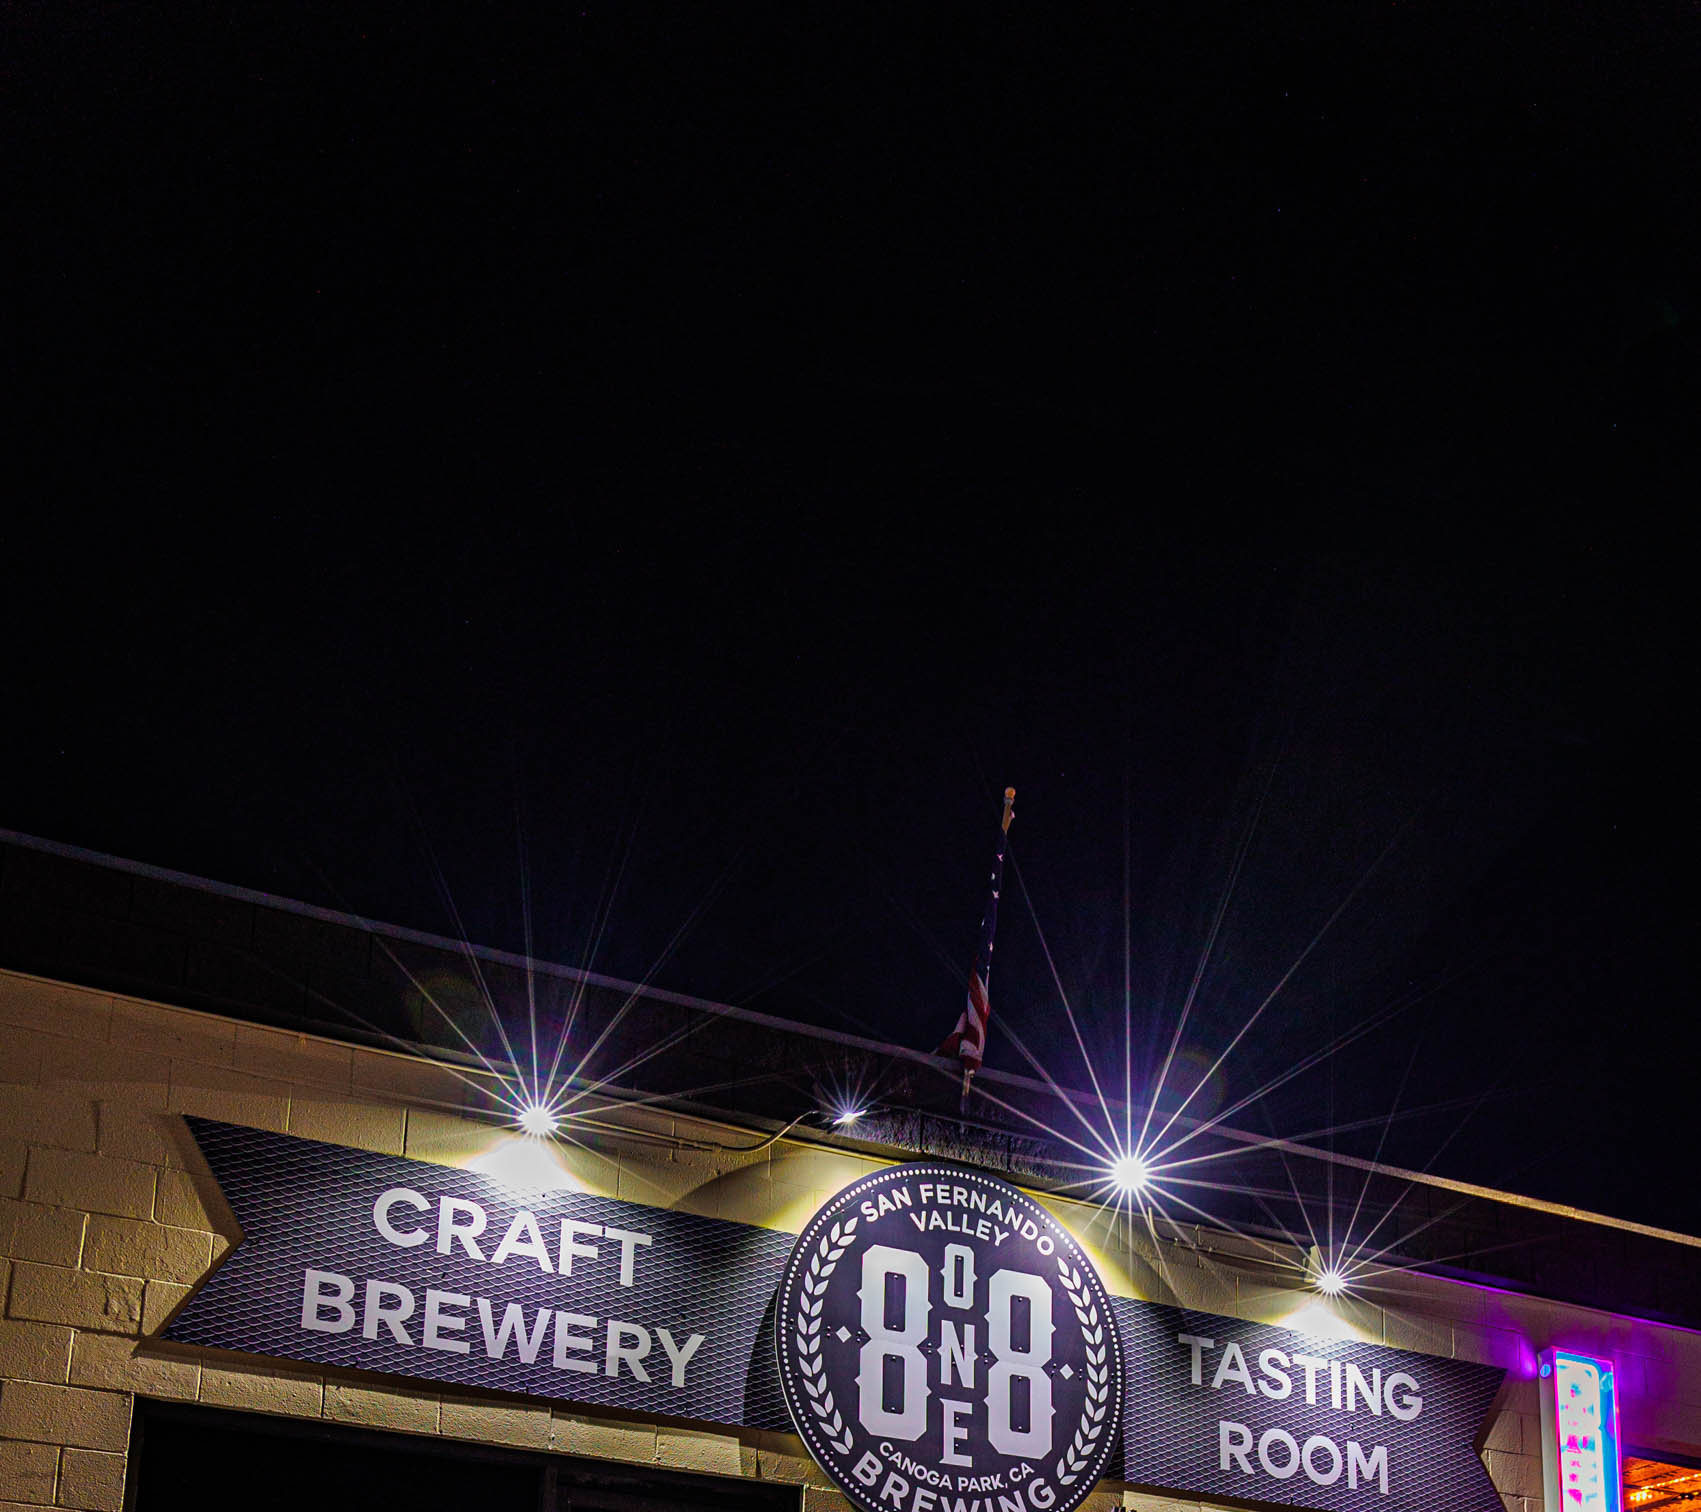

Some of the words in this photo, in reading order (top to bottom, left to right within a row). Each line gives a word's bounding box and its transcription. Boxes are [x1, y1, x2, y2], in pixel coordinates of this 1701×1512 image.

[373, 1188, 652, 1287] CRAFT
[861, 1185, 912, 1222] SAN
[920, 1183, 1055, 1256] FERNANDO
[909, 1211, 1010, 1247] VALLEY
[301, 1268, 705, 1388] BREWERY
[855, 1244, 933, 1441] 8
[983, 1268, 1056, 1460] 8
[1178, 1333, 1423, 1421] TASTING
[879, 1441, 953, 1490] CANOGA
[957, 1470, 1008, 1493] PARK,
[1009, 1462, 1035, 1483] CA
[1219, 1420, 1389, 1495] ROOM
